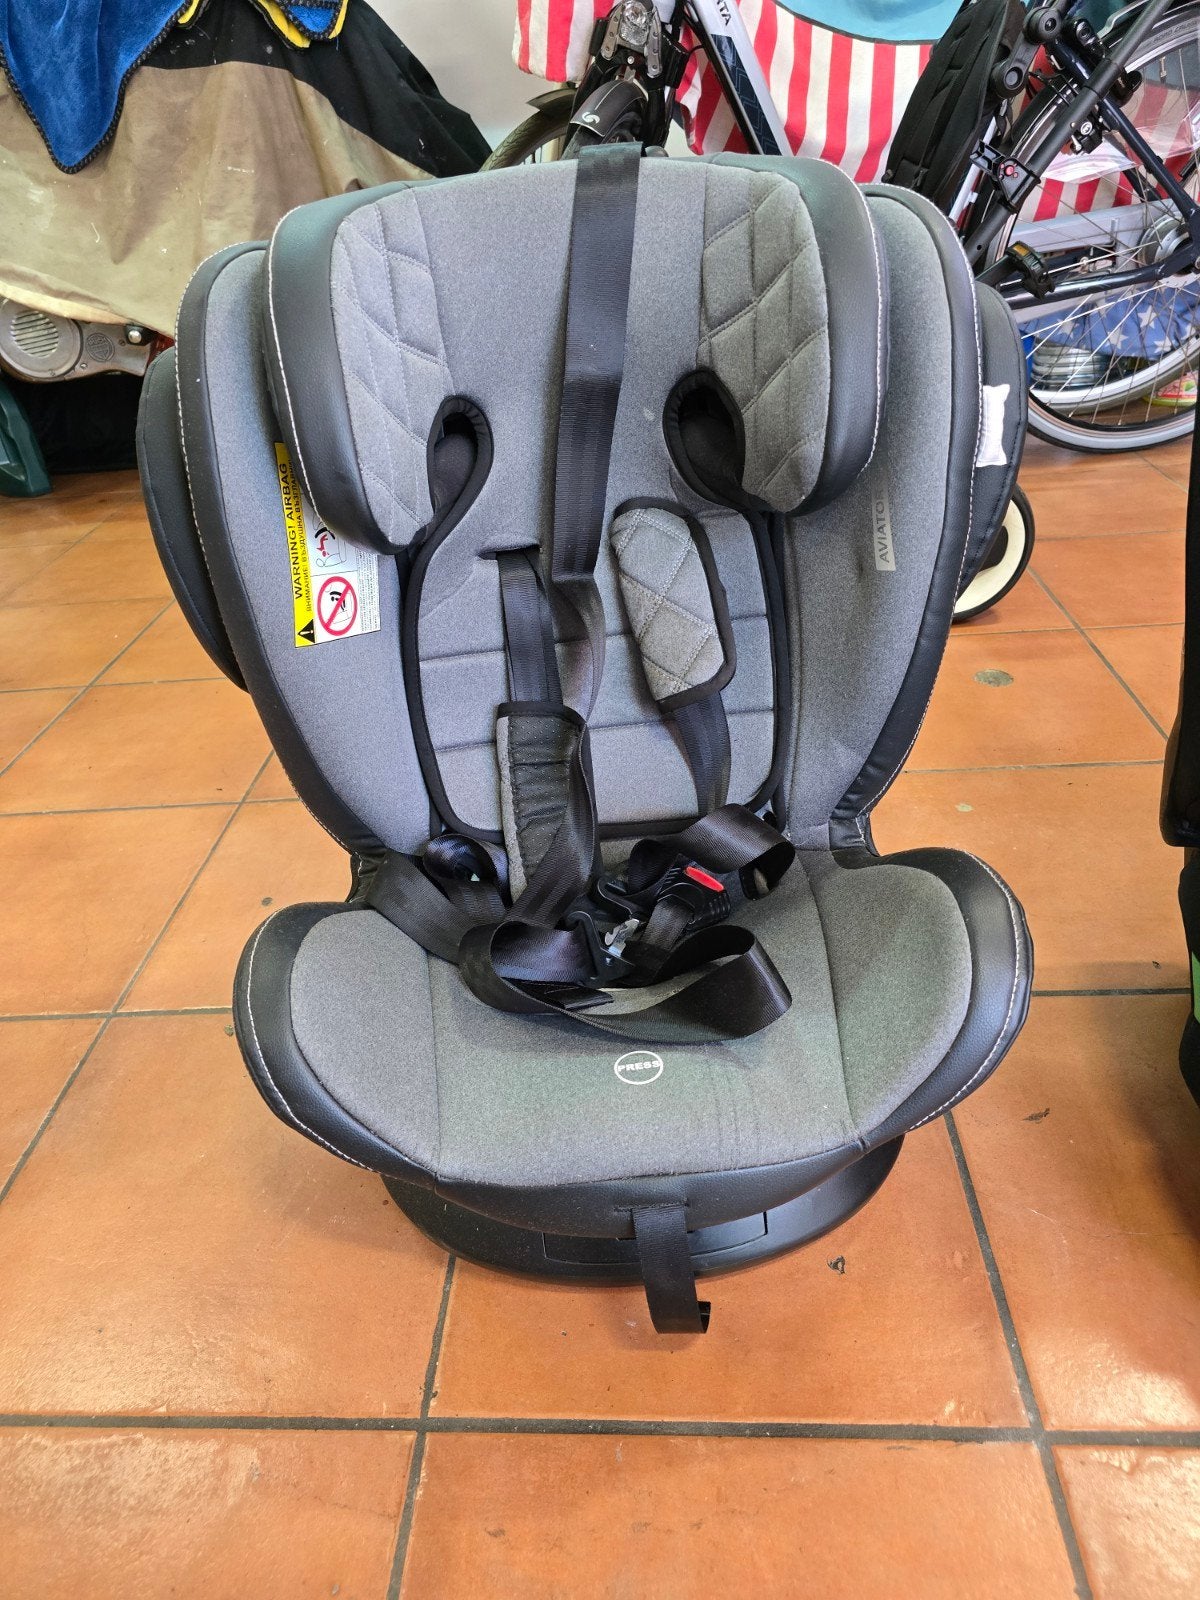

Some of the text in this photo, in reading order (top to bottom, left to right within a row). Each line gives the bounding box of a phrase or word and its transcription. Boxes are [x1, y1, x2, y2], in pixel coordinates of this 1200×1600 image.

[279, 463, 303, 600] WARNING! AIRBAG
[617, 1060, 661, 1072] PRESS
